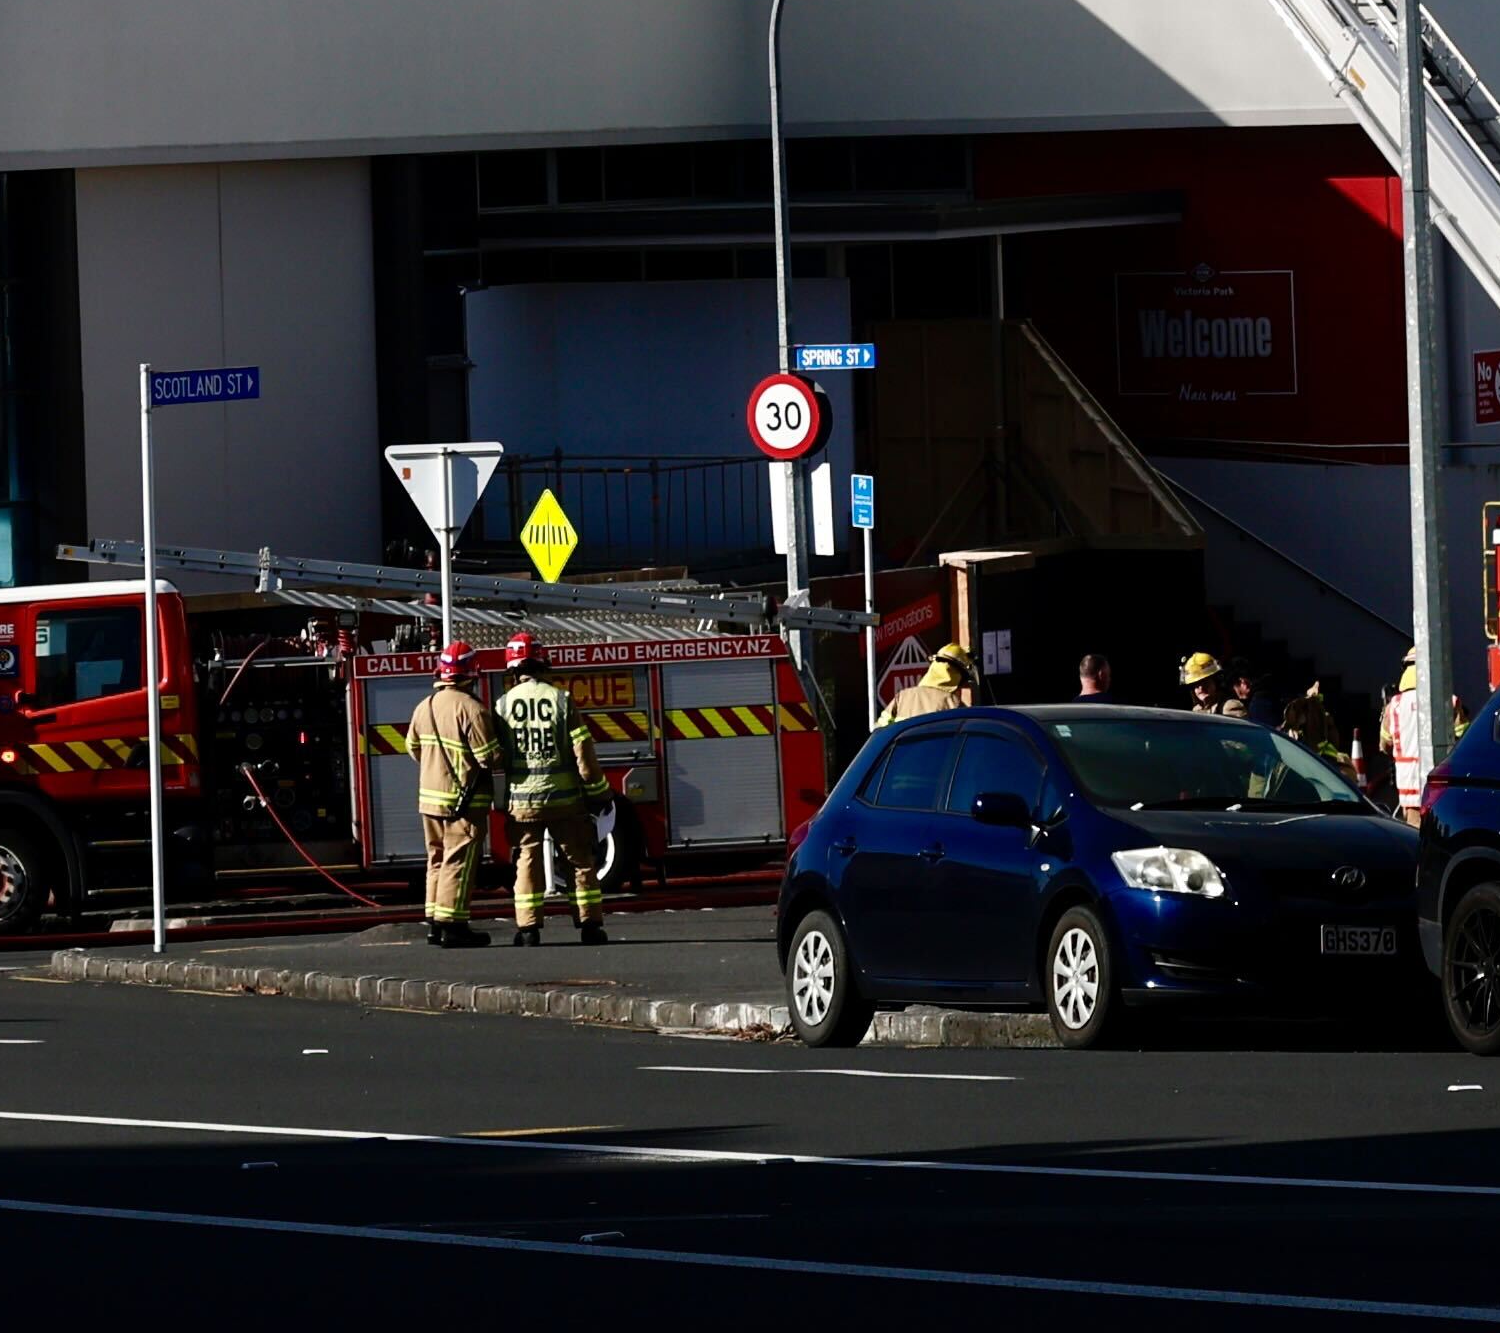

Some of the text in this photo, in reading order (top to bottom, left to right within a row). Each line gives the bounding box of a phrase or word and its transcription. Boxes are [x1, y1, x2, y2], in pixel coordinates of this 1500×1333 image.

[1137, 309, 1273, 358] Welcome
[802, 348, 860, 366] SPRING ST
[1477, 361, 1493, 382] No
[155, 373, 243, 399] SCOTLAND ST
[766, 401, 801, 431] 30
[367, 656, 414, 674] CALL
[548, 646, 588, 664] FIRE
[591, 644, 630, 662] AND
[634, 637, 771, 660] EMERGENCY.NZ
[512, 698, 553, 722] OIC
[515, 727, 555, 754] FIRE
